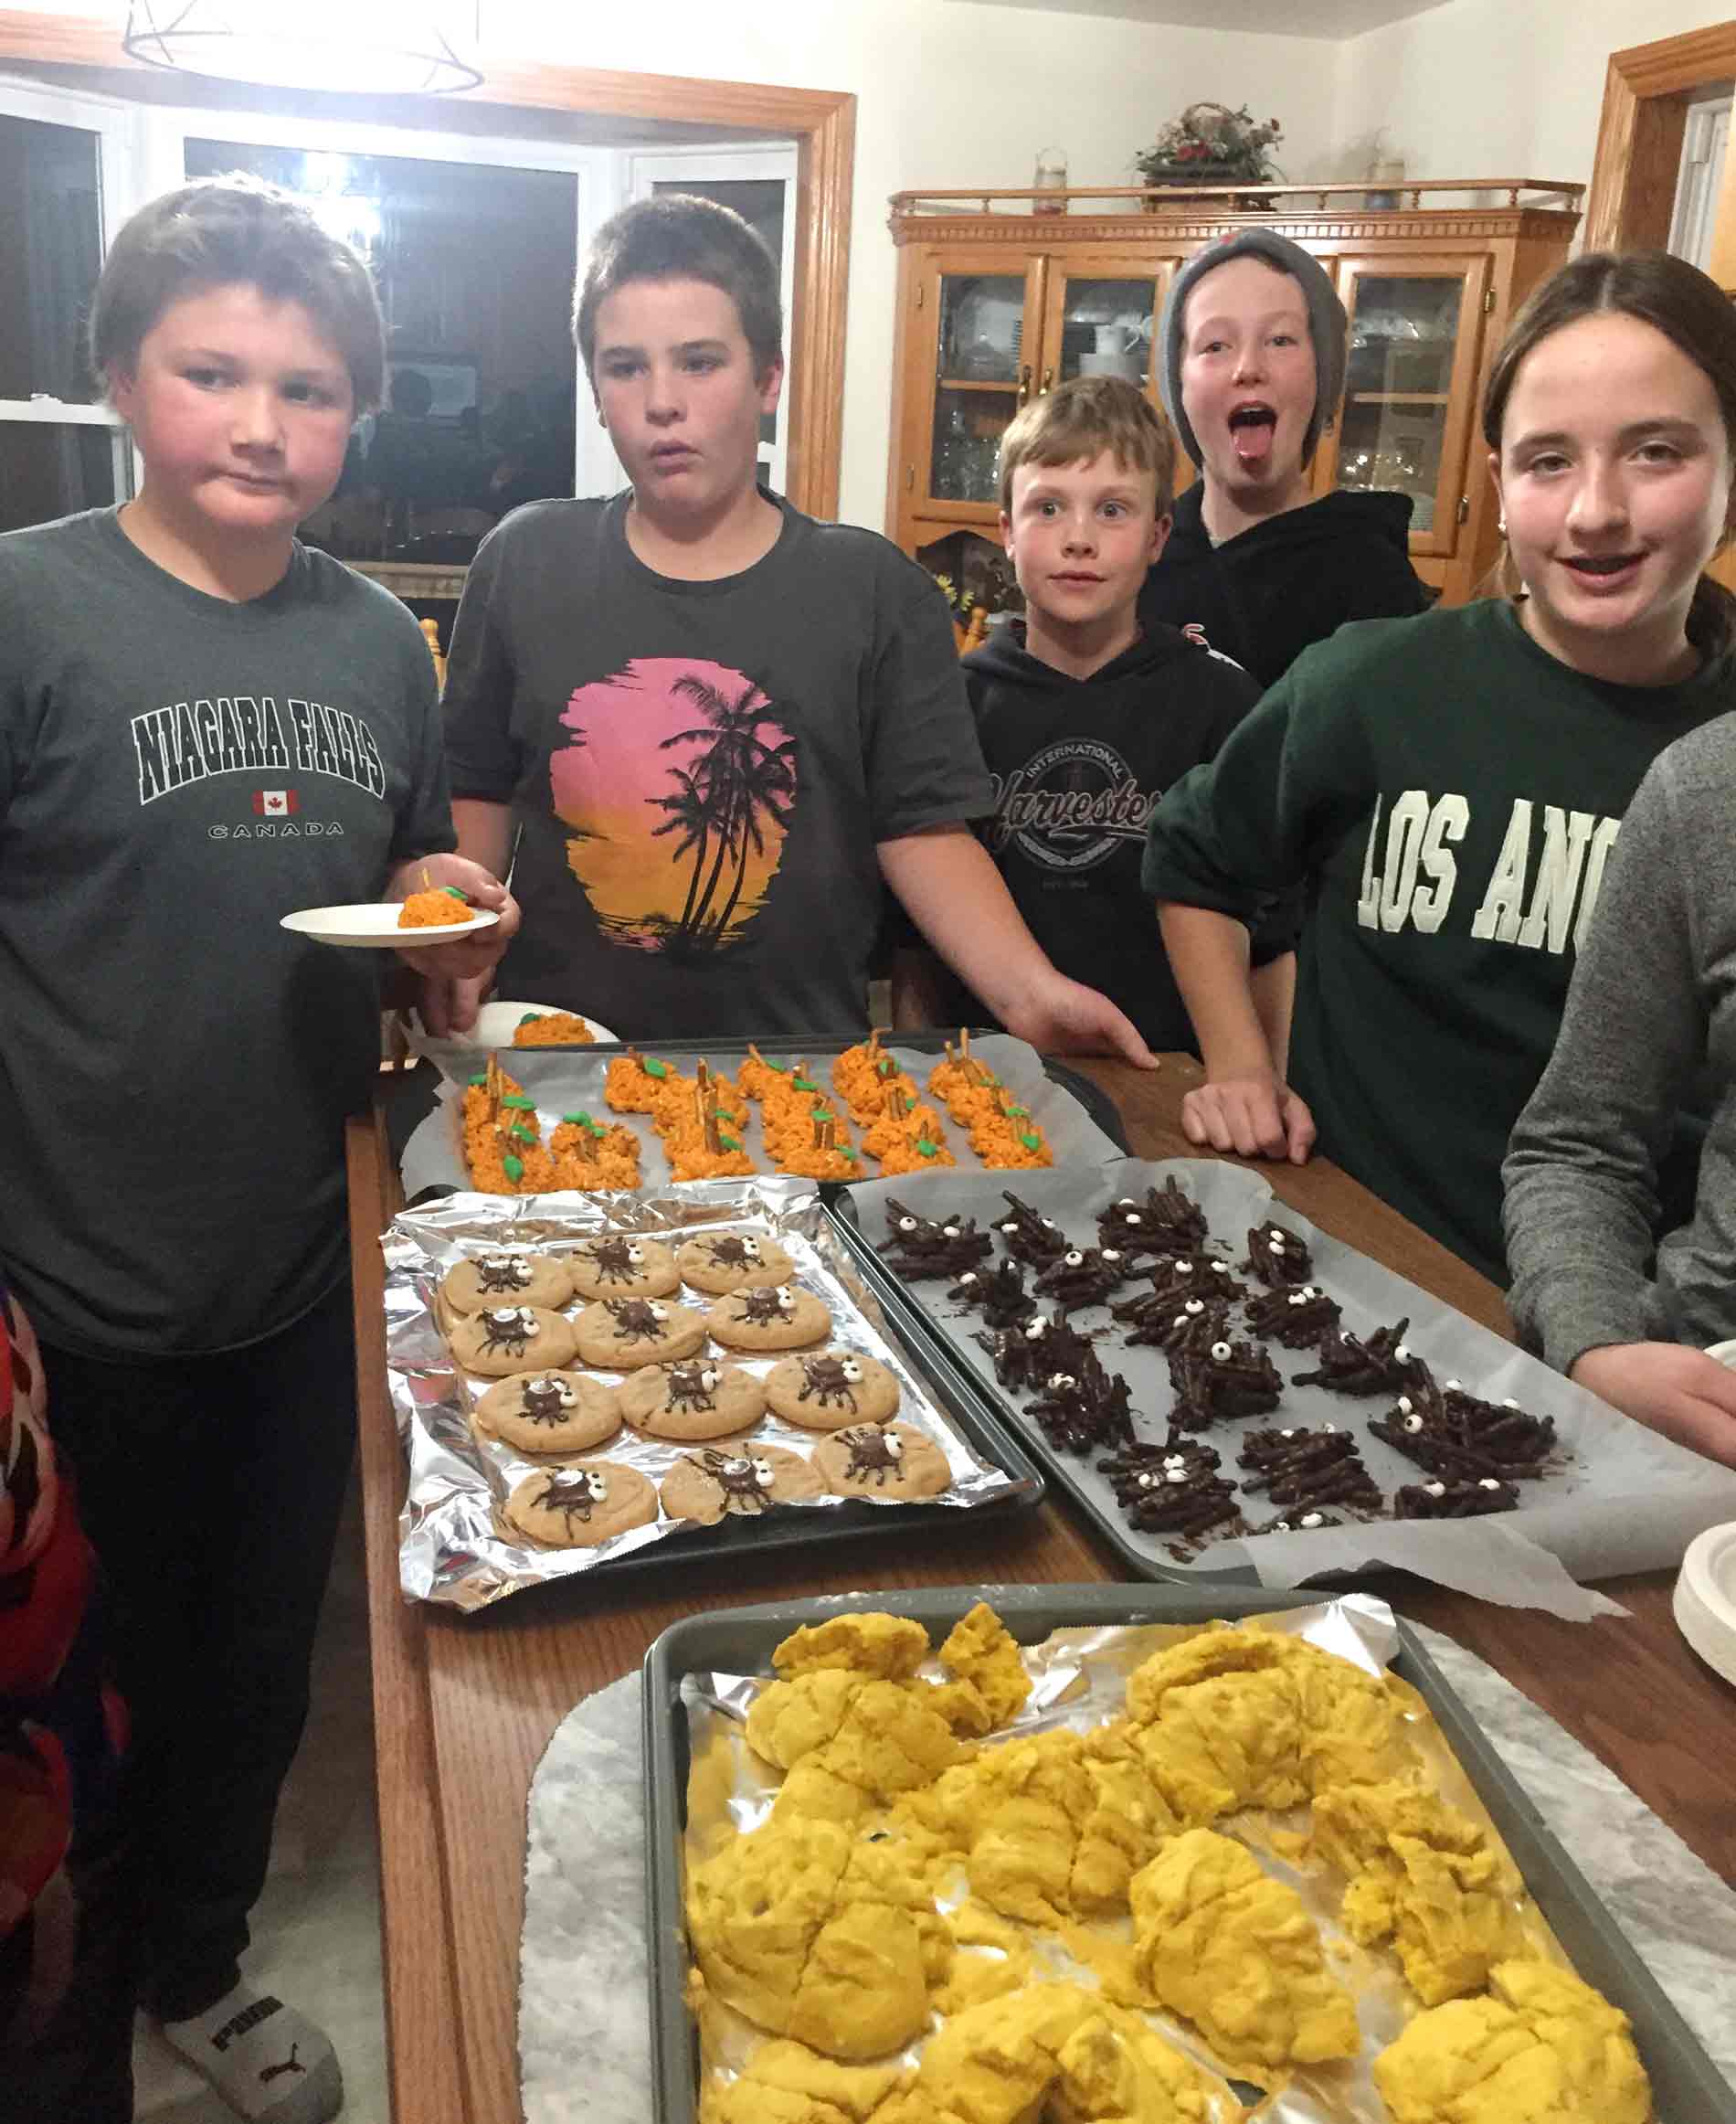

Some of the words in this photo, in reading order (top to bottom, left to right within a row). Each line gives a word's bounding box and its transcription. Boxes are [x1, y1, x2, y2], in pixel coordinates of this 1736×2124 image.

[131, 696, 290, 805] NIAGARA
[288, 698, 386, 800] FALLS
[1026, 744, 1125, 779] INTERNATIONAL
[207, 823, 344, 839] CANADA
[1358, 791, 1470, 933] LOS
